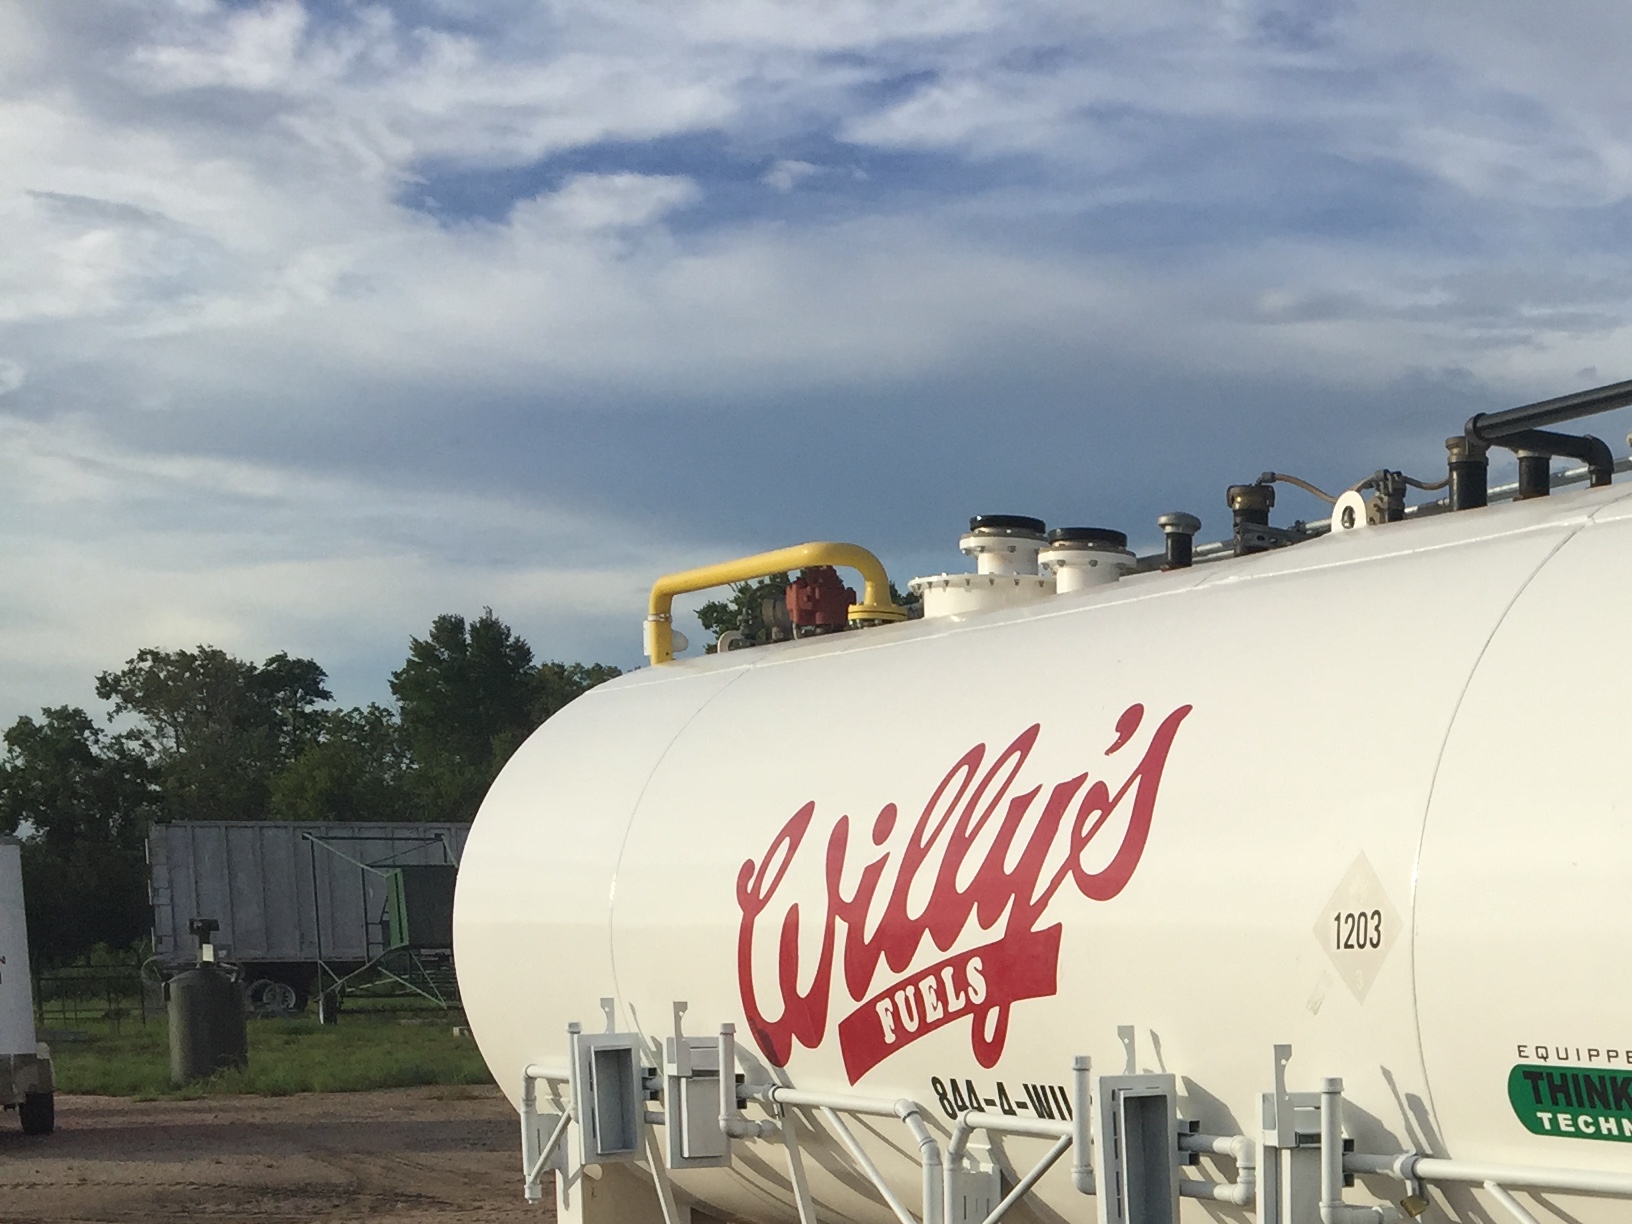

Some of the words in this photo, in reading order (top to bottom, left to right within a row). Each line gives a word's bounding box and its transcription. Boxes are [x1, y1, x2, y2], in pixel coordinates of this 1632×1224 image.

[736, 702, 1193, 1069] Willy's
[1334, 909, 1382, 950] 1203
[875, 956, 988, 1044] FUELS
